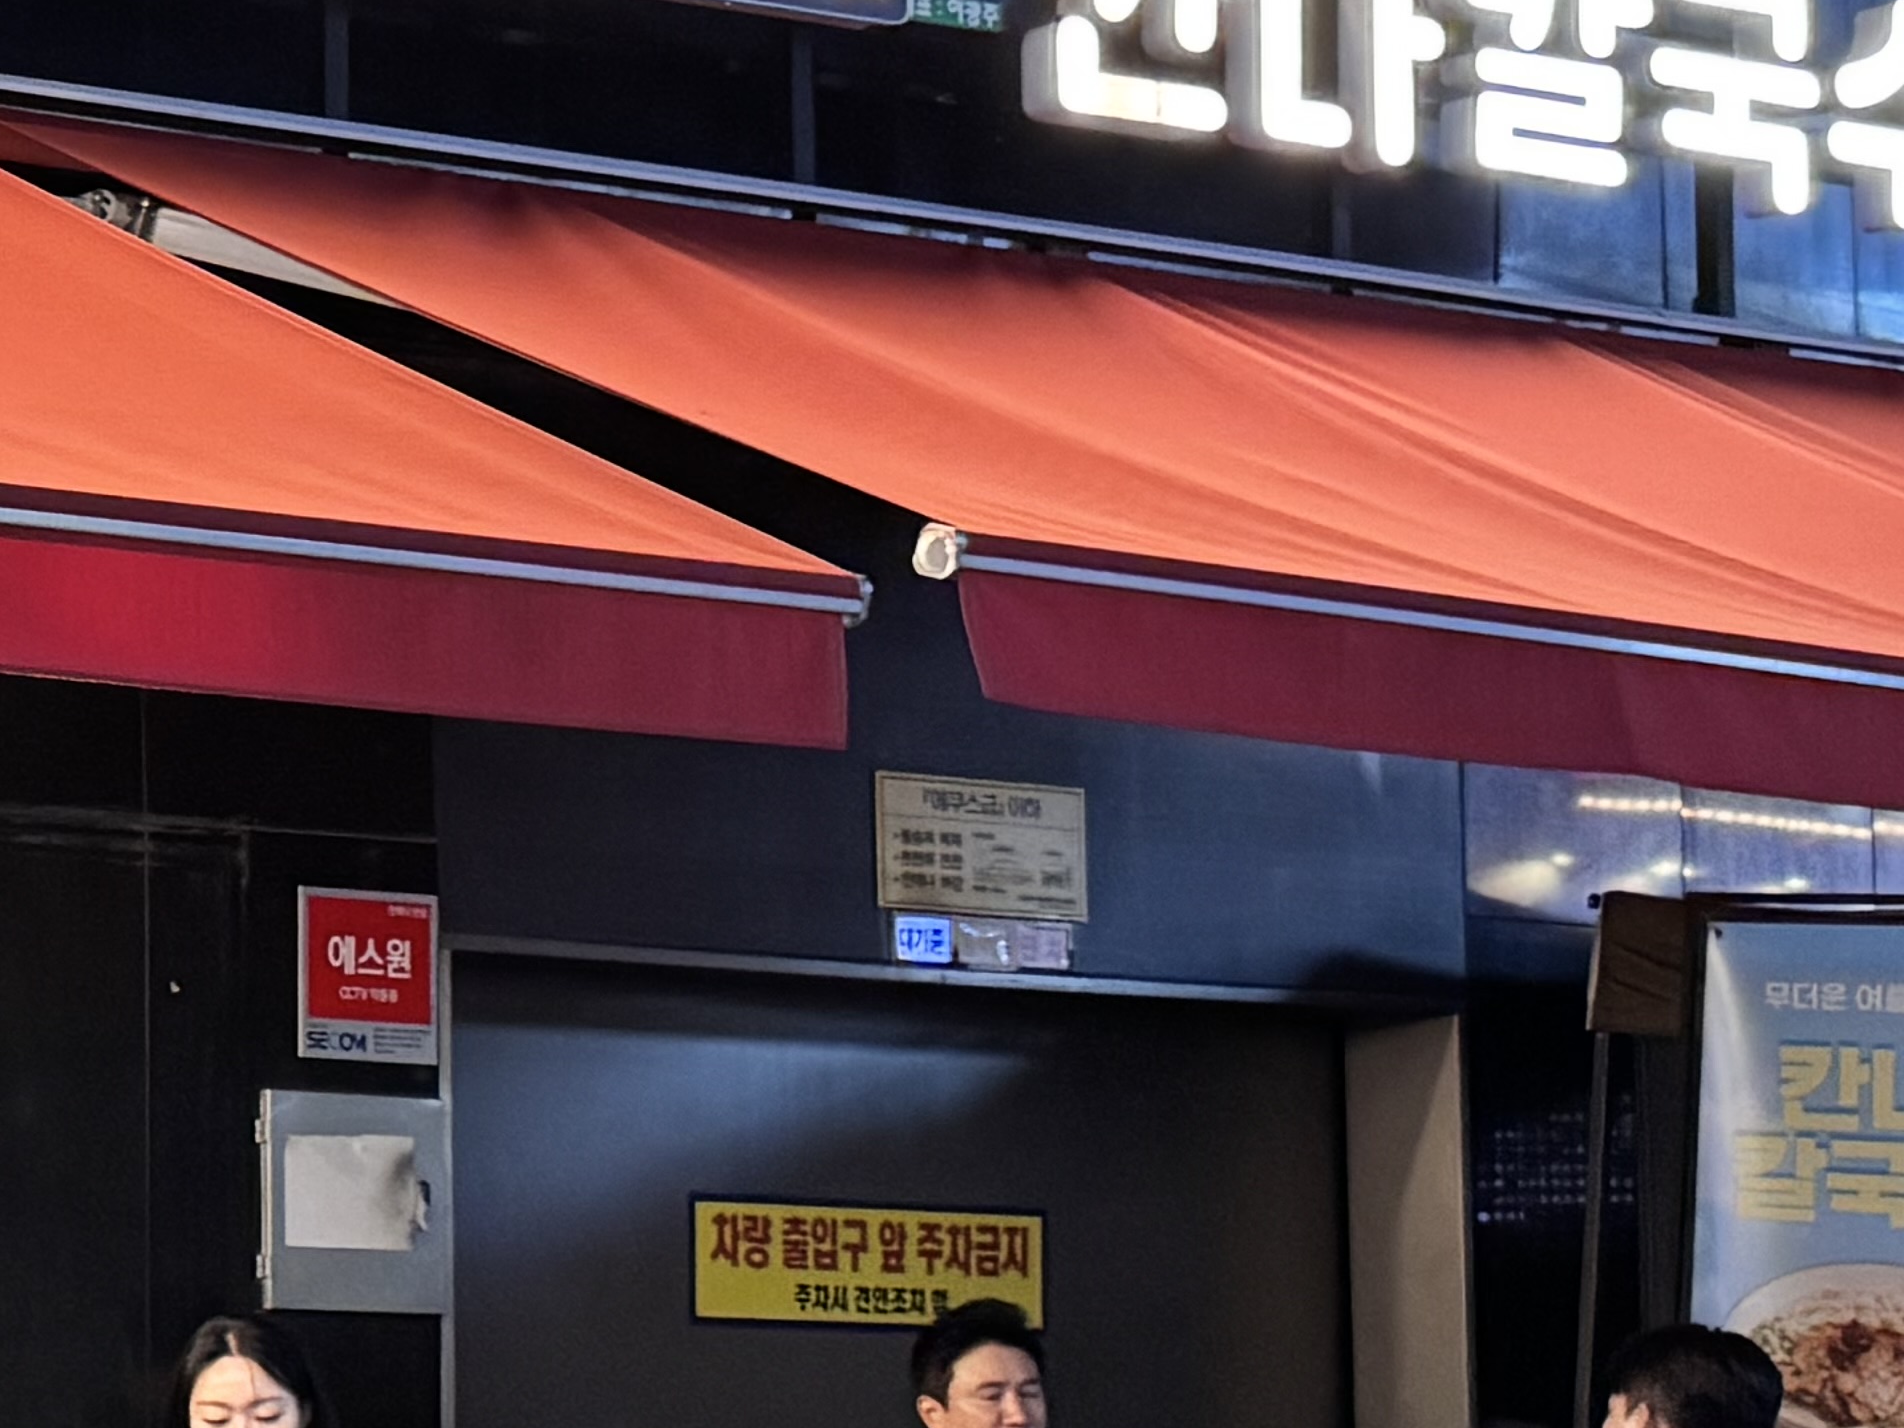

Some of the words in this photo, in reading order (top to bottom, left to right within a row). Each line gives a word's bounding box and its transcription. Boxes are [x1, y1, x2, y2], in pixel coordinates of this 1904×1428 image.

[327, 934, 413, 979] 에스원
[1765, 981, 1848, 1012] 무더운
[710, 1211, 772, 1270] 차량
[781, 1215, 869, 1273] 출입구
[879, 1220, 907, 1274] 앞
[916, 1222, 1029, 1278] 주차금지
